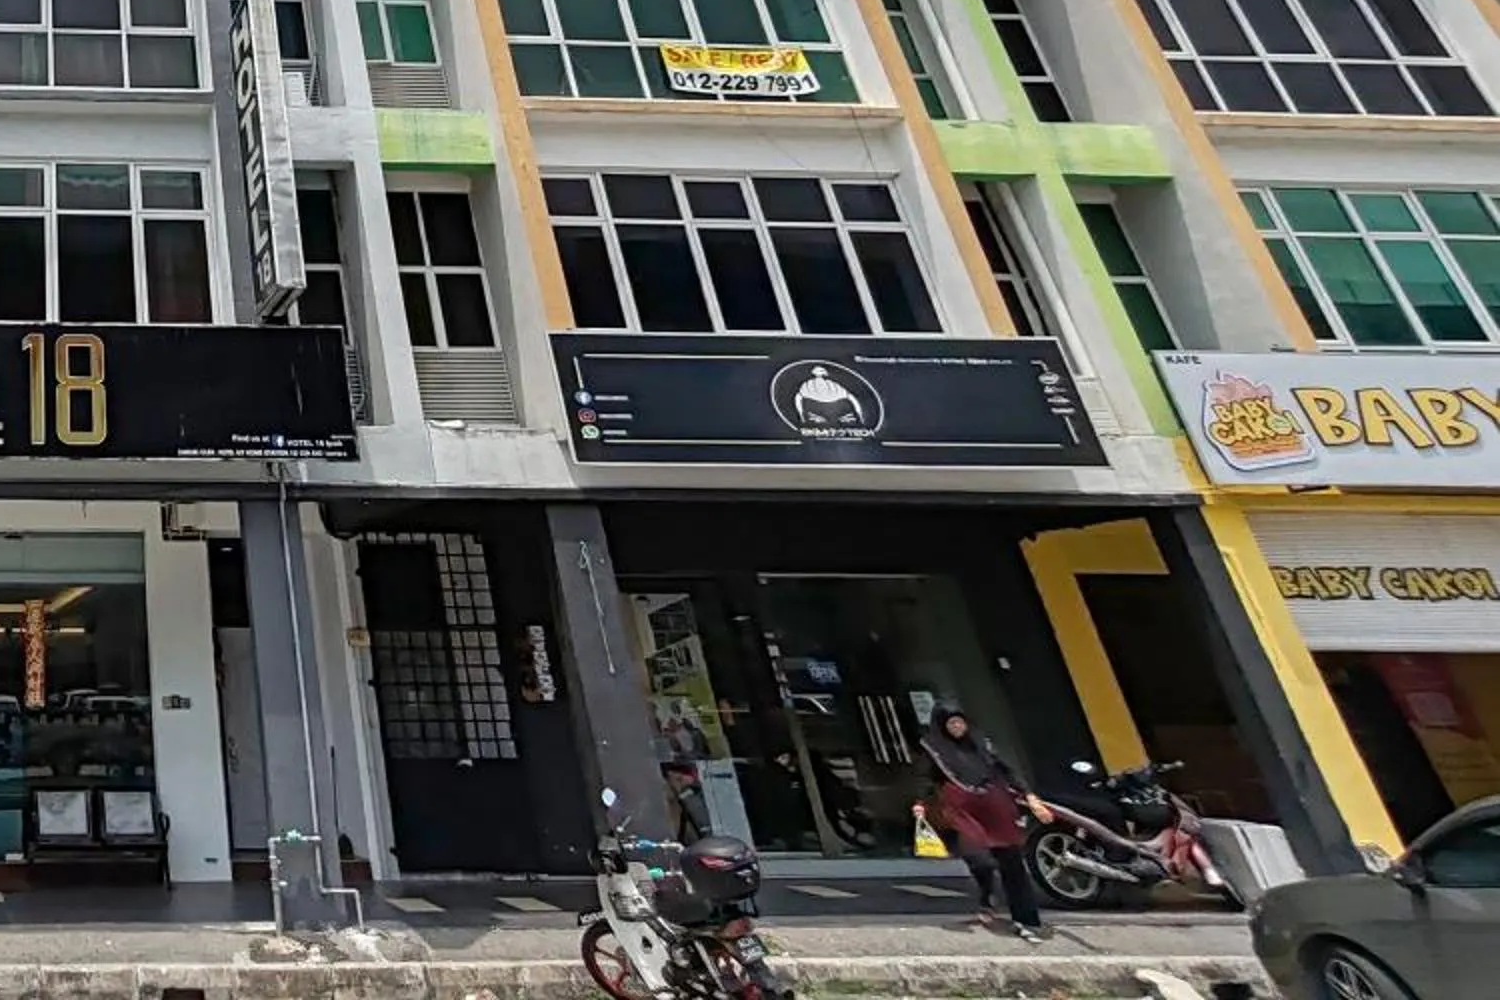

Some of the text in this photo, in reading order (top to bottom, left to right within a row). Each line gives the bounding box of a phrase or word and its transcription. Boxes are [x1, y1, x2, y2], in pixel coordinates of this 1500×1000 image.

[673, 71, 815, 93] 012-229 7991
[232, 4, 269, 256] HOTEL
[1165, 355, 1201, 365] KAFE
[21, 332, 107, 446] 18
[1209, 408, 1305, 447] CAKOI
[1211, 396, 1274, 424] BABY
[1269, 565, 1500, 602] BABY CAKOI
